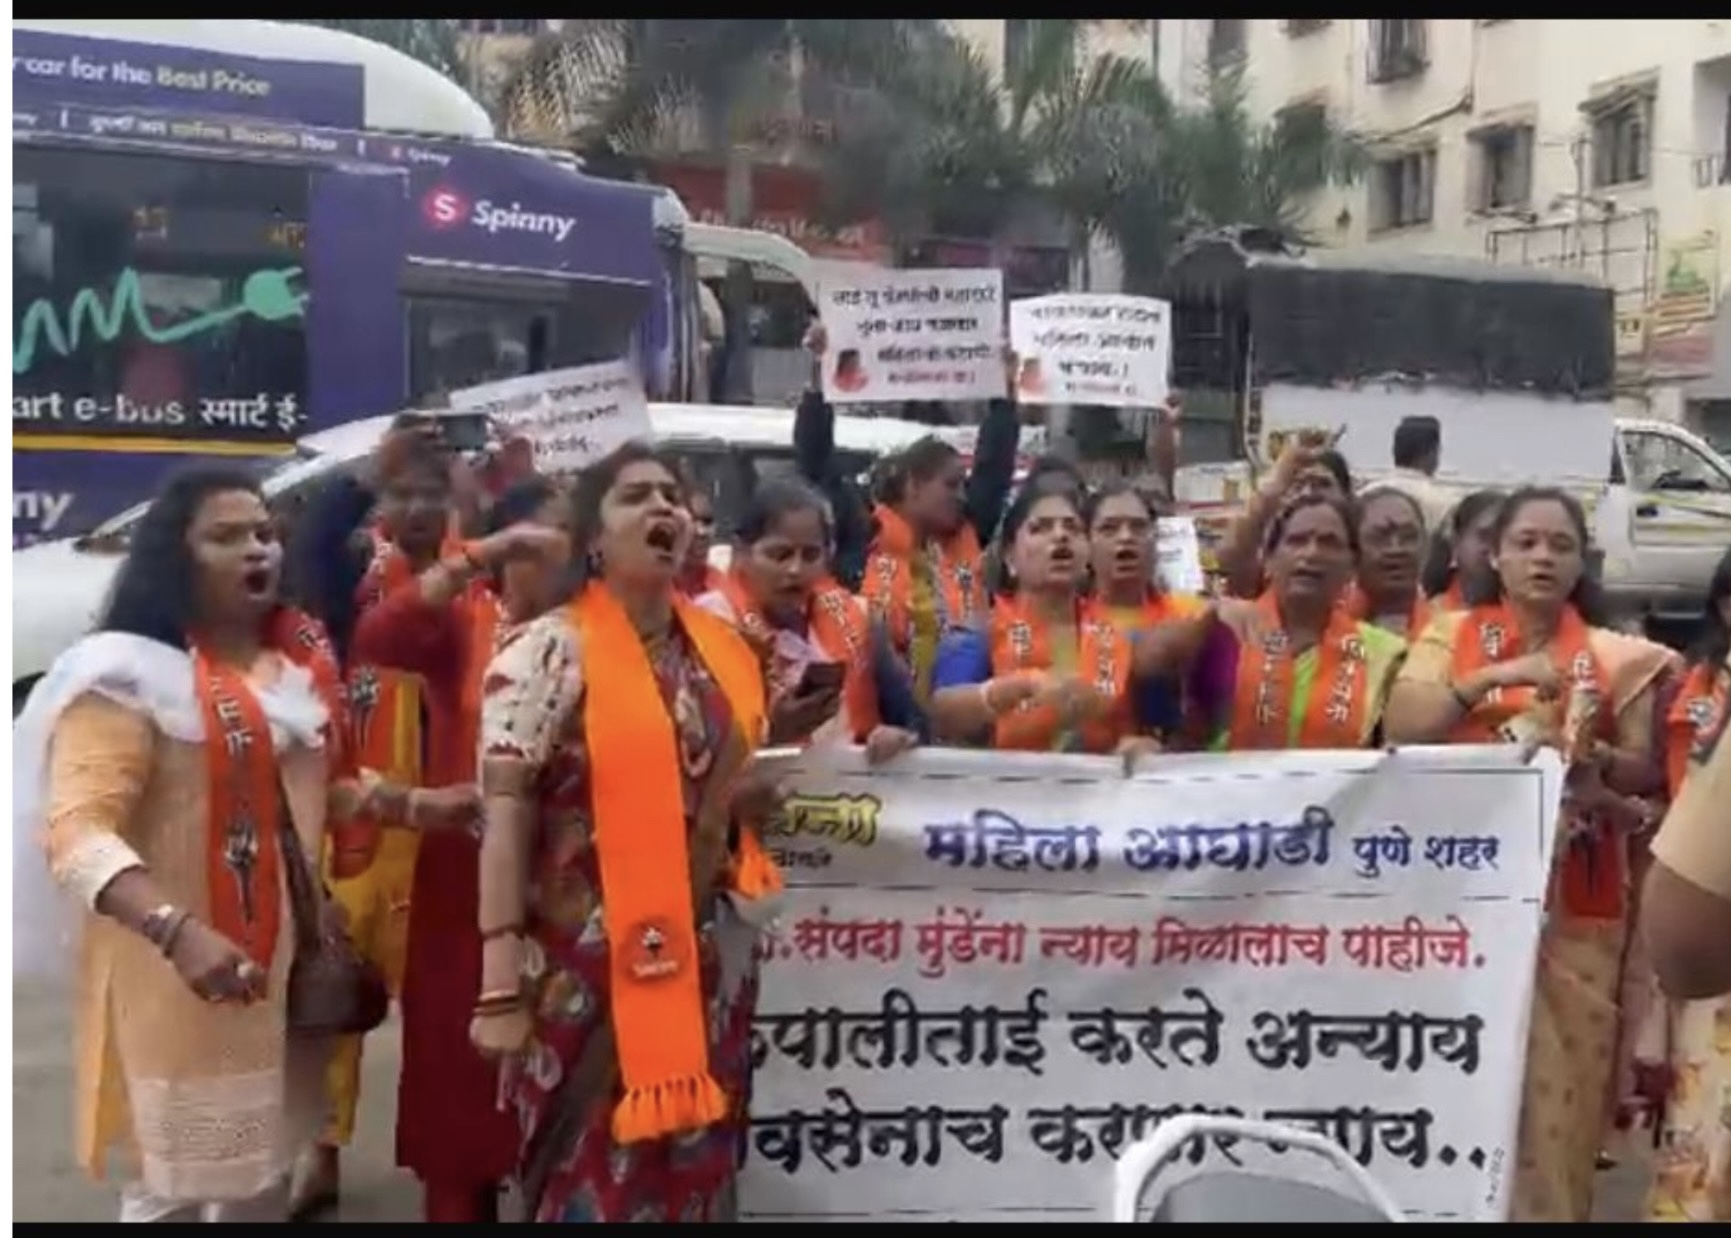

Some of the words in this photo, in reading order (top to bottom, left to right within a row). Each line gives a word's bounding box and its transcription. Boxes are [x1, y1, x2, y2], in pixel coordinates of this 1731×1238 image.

[26, 58, 65, 75] car
[70, 55, 107, 79] for
[112, 61, 151, 85] the
[157, 65, 207, 90] Best
[212, 71, 272, 96] Price
[472, 199, 577, 242] Spinny
[12, 392, 62, 420] art
[74, 394, 186, 425] e-bus
[200, 392, 268, 428] स्मार्ट
[924, 809, 1101, 873] महिला
[1124, 804, 1335, 872] आघाडी
[1352, 824, 1413, 879] पुणे
[1425, 834, 1499, 871] शहर
[754, 905, 904, 965] .संपदा
[914, 906, 1026, 979] मुंडेंना
[1038, 921, 1141, 968] न्याय
[1153, 916, 1329, 969] मिळालाच
[1342, 914, 1488, 973] पाहीजे.
[1066, 987, 1224, 1069] करते
[1246, 1008, 1485, 1074] अन्याय
[748, 1088, 1010, 1174] वसेनाच
